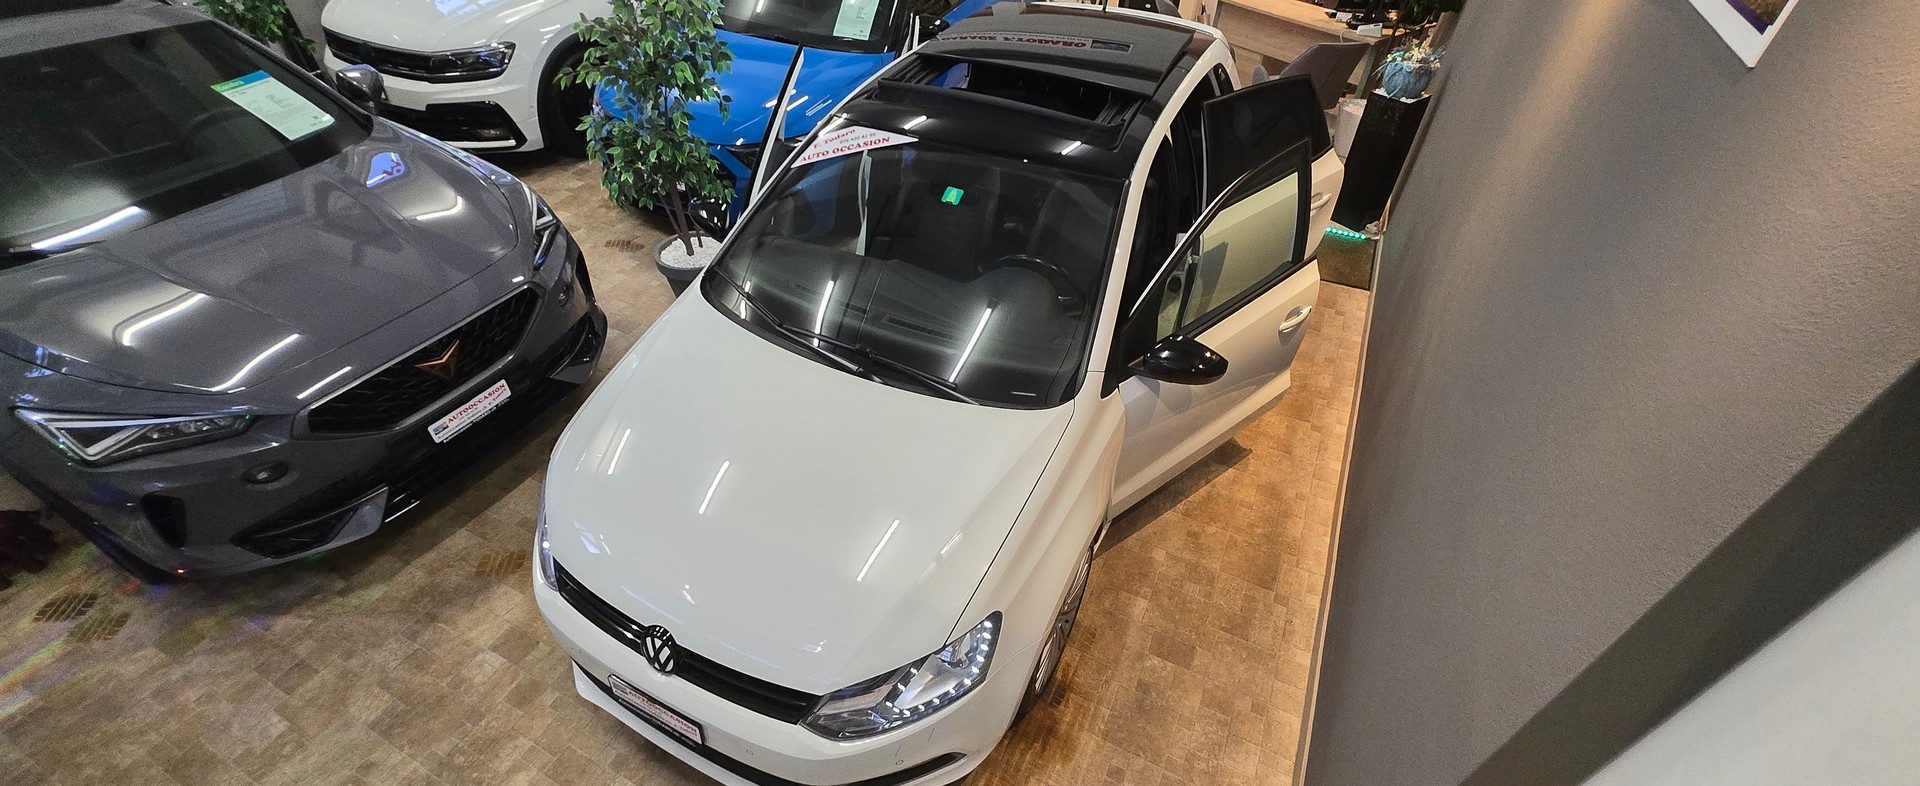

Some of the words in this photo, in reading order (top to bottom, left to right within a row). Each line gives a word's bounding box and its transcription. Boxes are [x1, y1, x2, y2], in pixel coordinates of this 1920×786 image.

[824, 129, 856, 144] Todaro
[800, 150, 829, 162] AUTO
[832, 137, 891, 154] OCCASION
[447, 383, 506, 424] AUTOOCCASION
